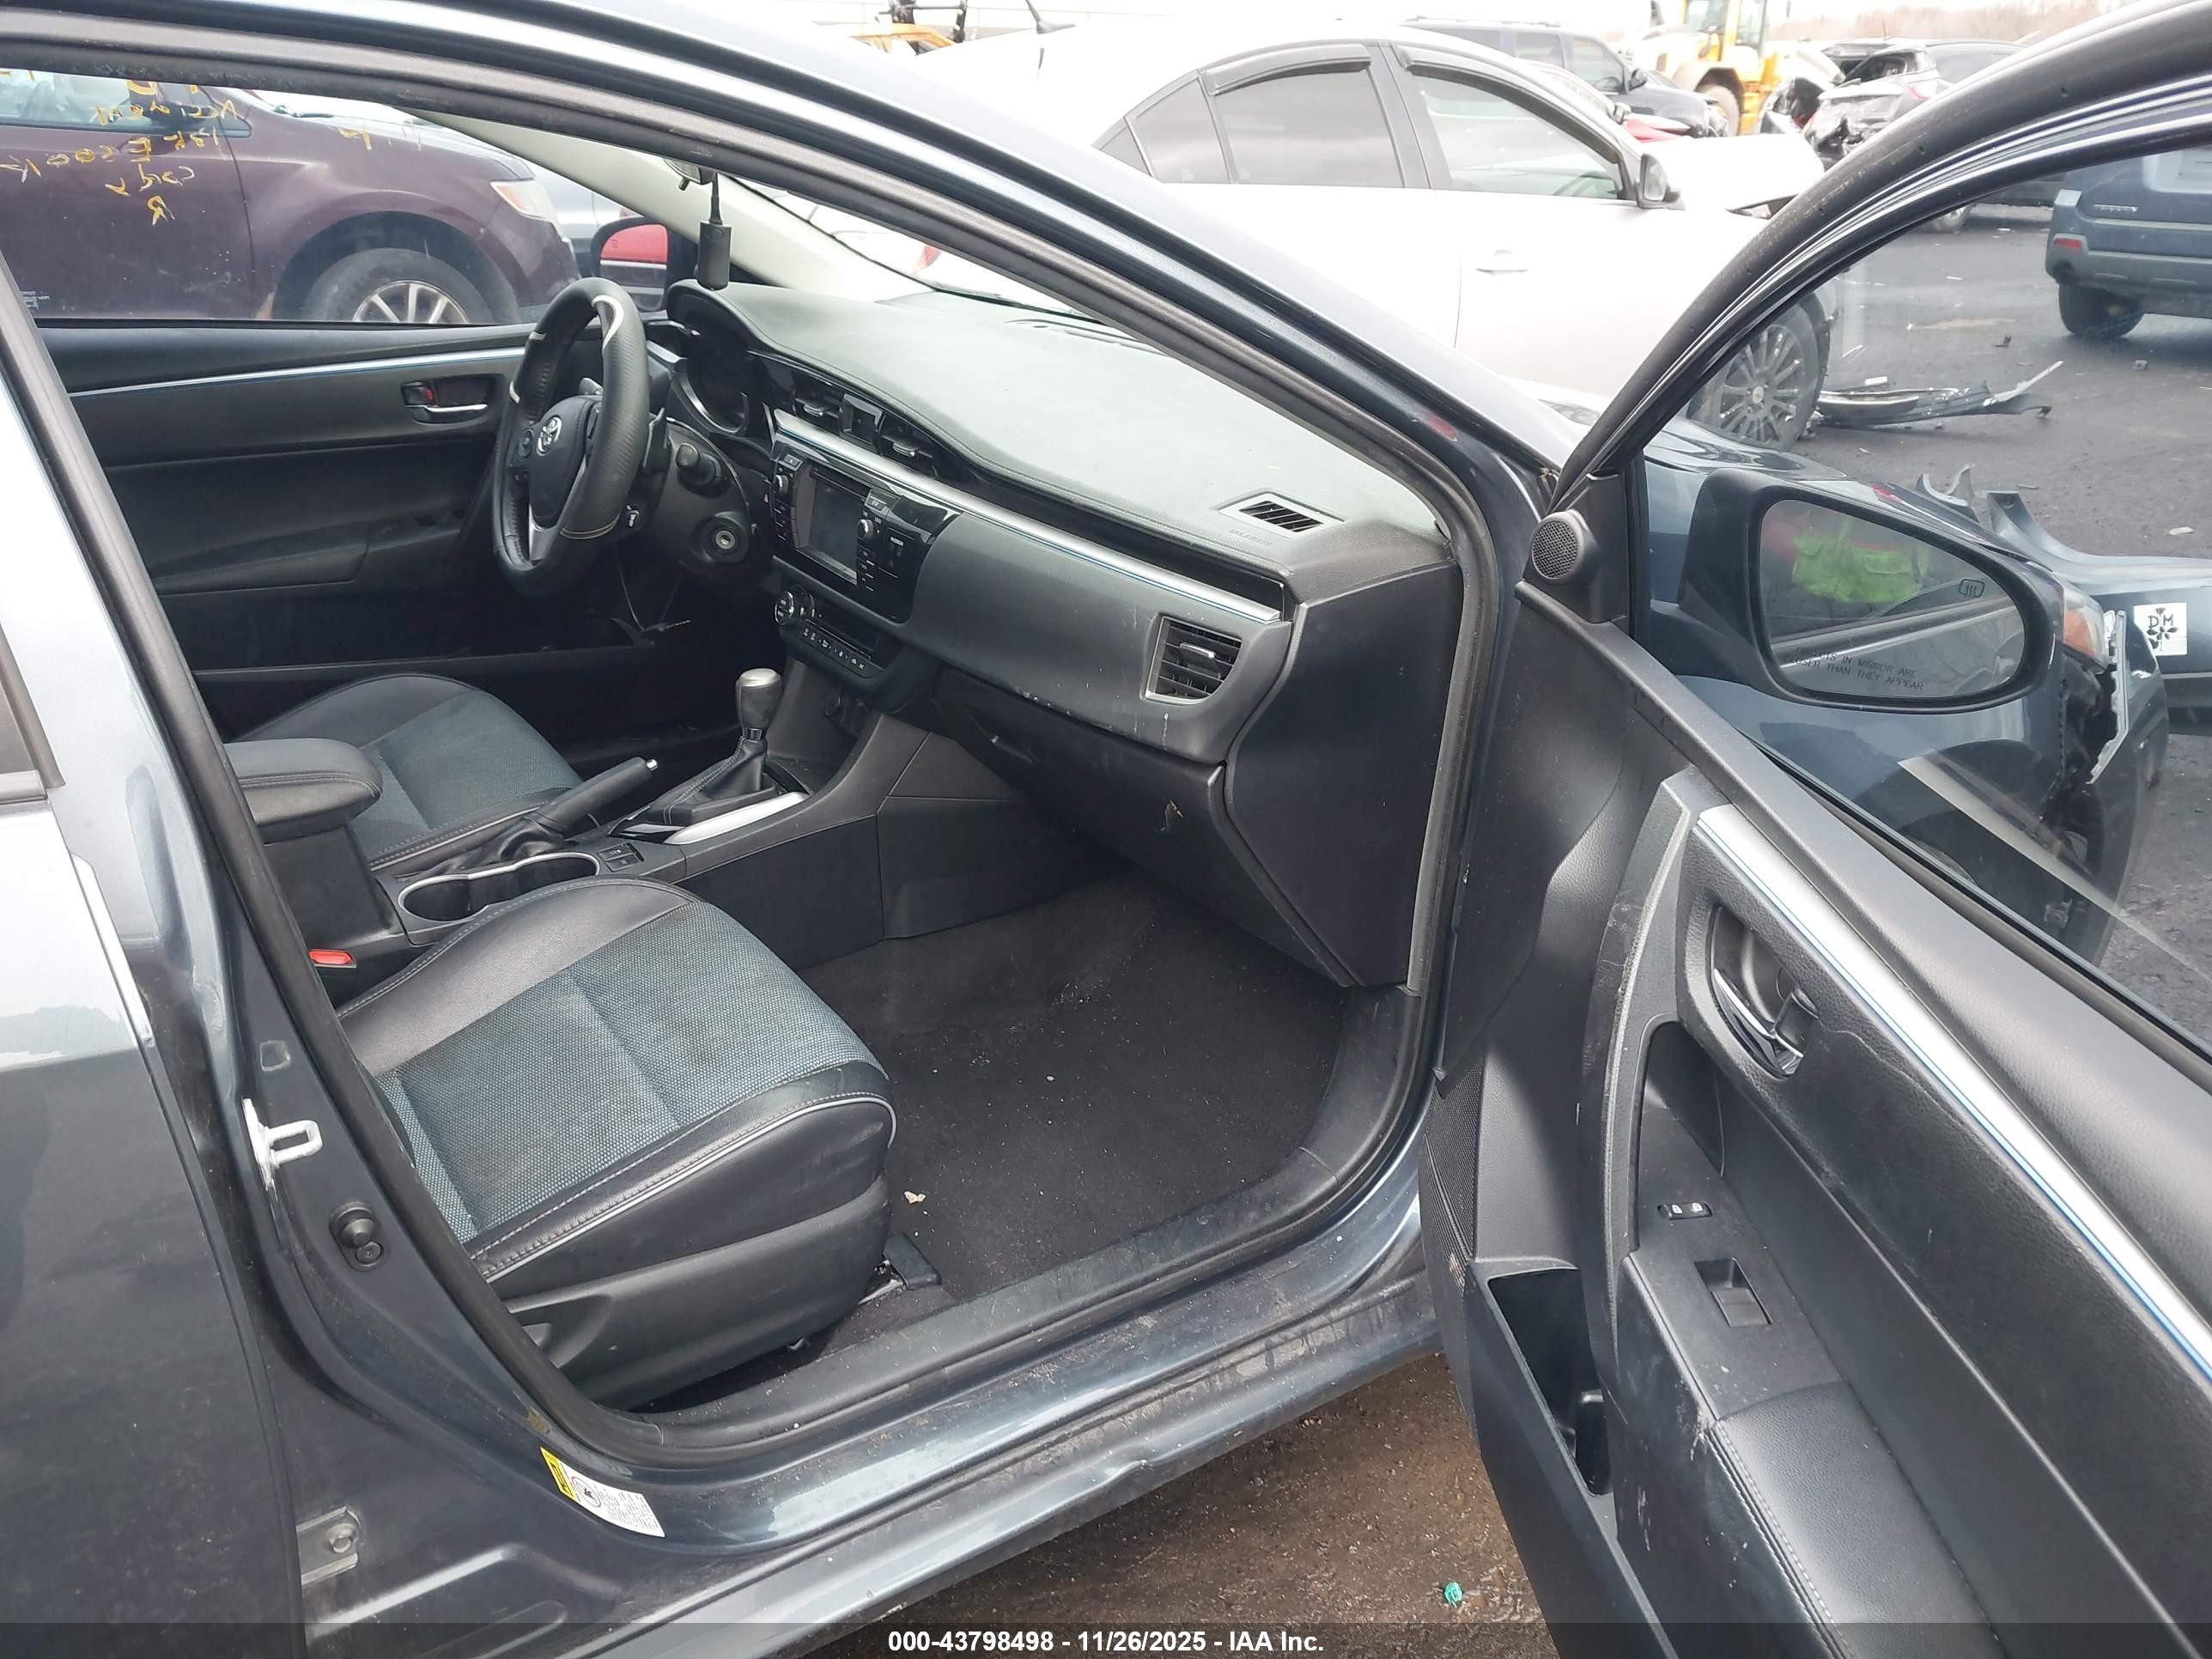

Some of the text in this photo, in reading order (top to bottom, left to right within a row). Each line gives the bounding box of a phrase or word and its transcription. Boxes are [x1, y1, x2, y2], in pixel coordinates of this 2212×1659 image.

[1826, 663, 1851, 676] THAN
[1856, 670, 1881, 681] THEY
[1885, 676, 1924, 691] APPEAR
[1842, 655, 1853, 665] IN
[1856, 658, 1894, 674] MIRROR
[1898, 666, 1917, 679] ARE
